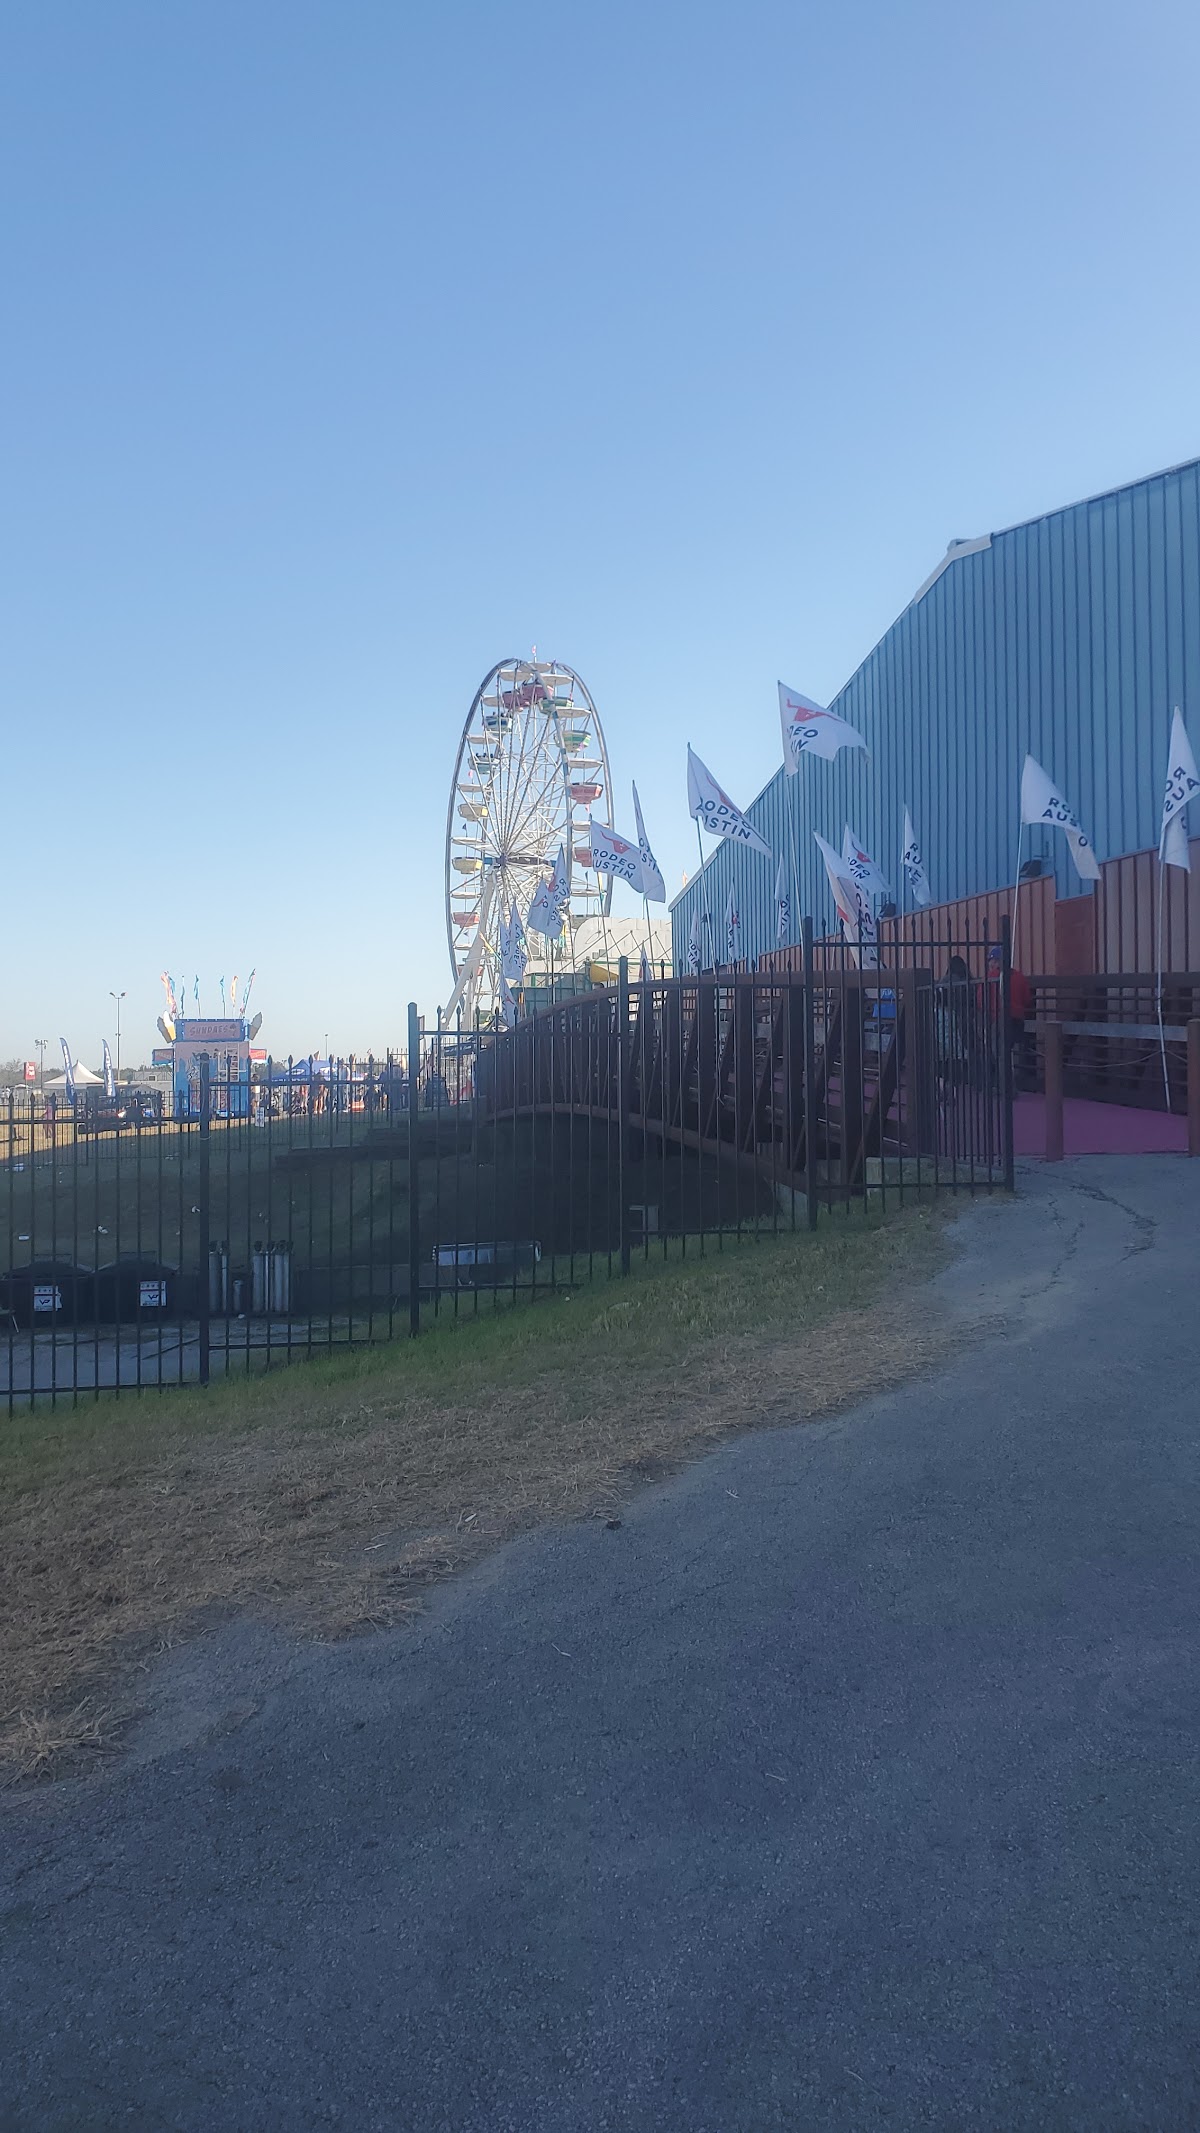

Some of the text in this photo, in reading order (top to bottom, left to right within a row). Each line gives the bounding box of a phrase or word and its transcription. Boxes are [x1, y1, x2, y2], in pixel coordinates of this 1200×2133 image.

[593, 848, 637, 870] RODEO
[595, 859, 634, 879] USTIN
[189, 1024, 228, 1037] SUNDAES
